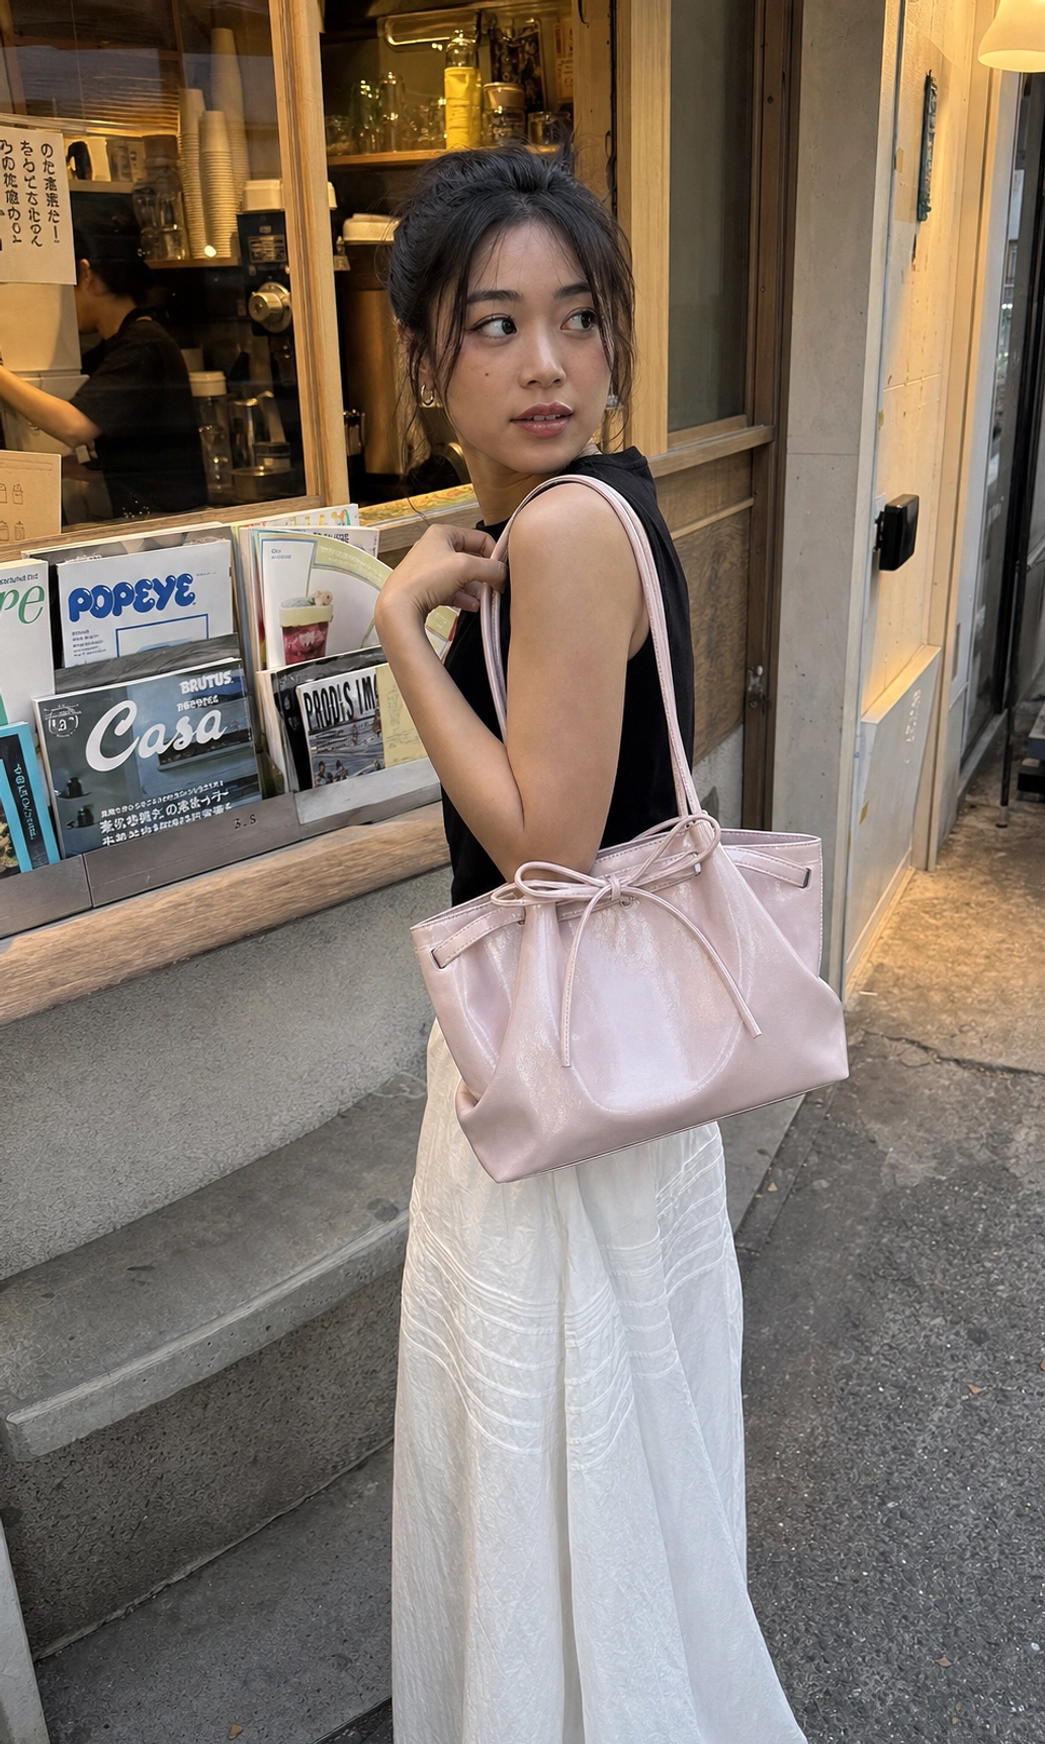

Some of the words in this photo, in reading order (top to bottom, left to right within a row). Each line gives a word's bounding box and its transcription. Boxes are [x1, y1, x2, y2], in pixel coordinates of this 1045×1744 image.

[68, 573, 196, 623] POPEYE
[179, 669, 232, 694] BRUTUS
[85, 700, 228, 772] Casa
